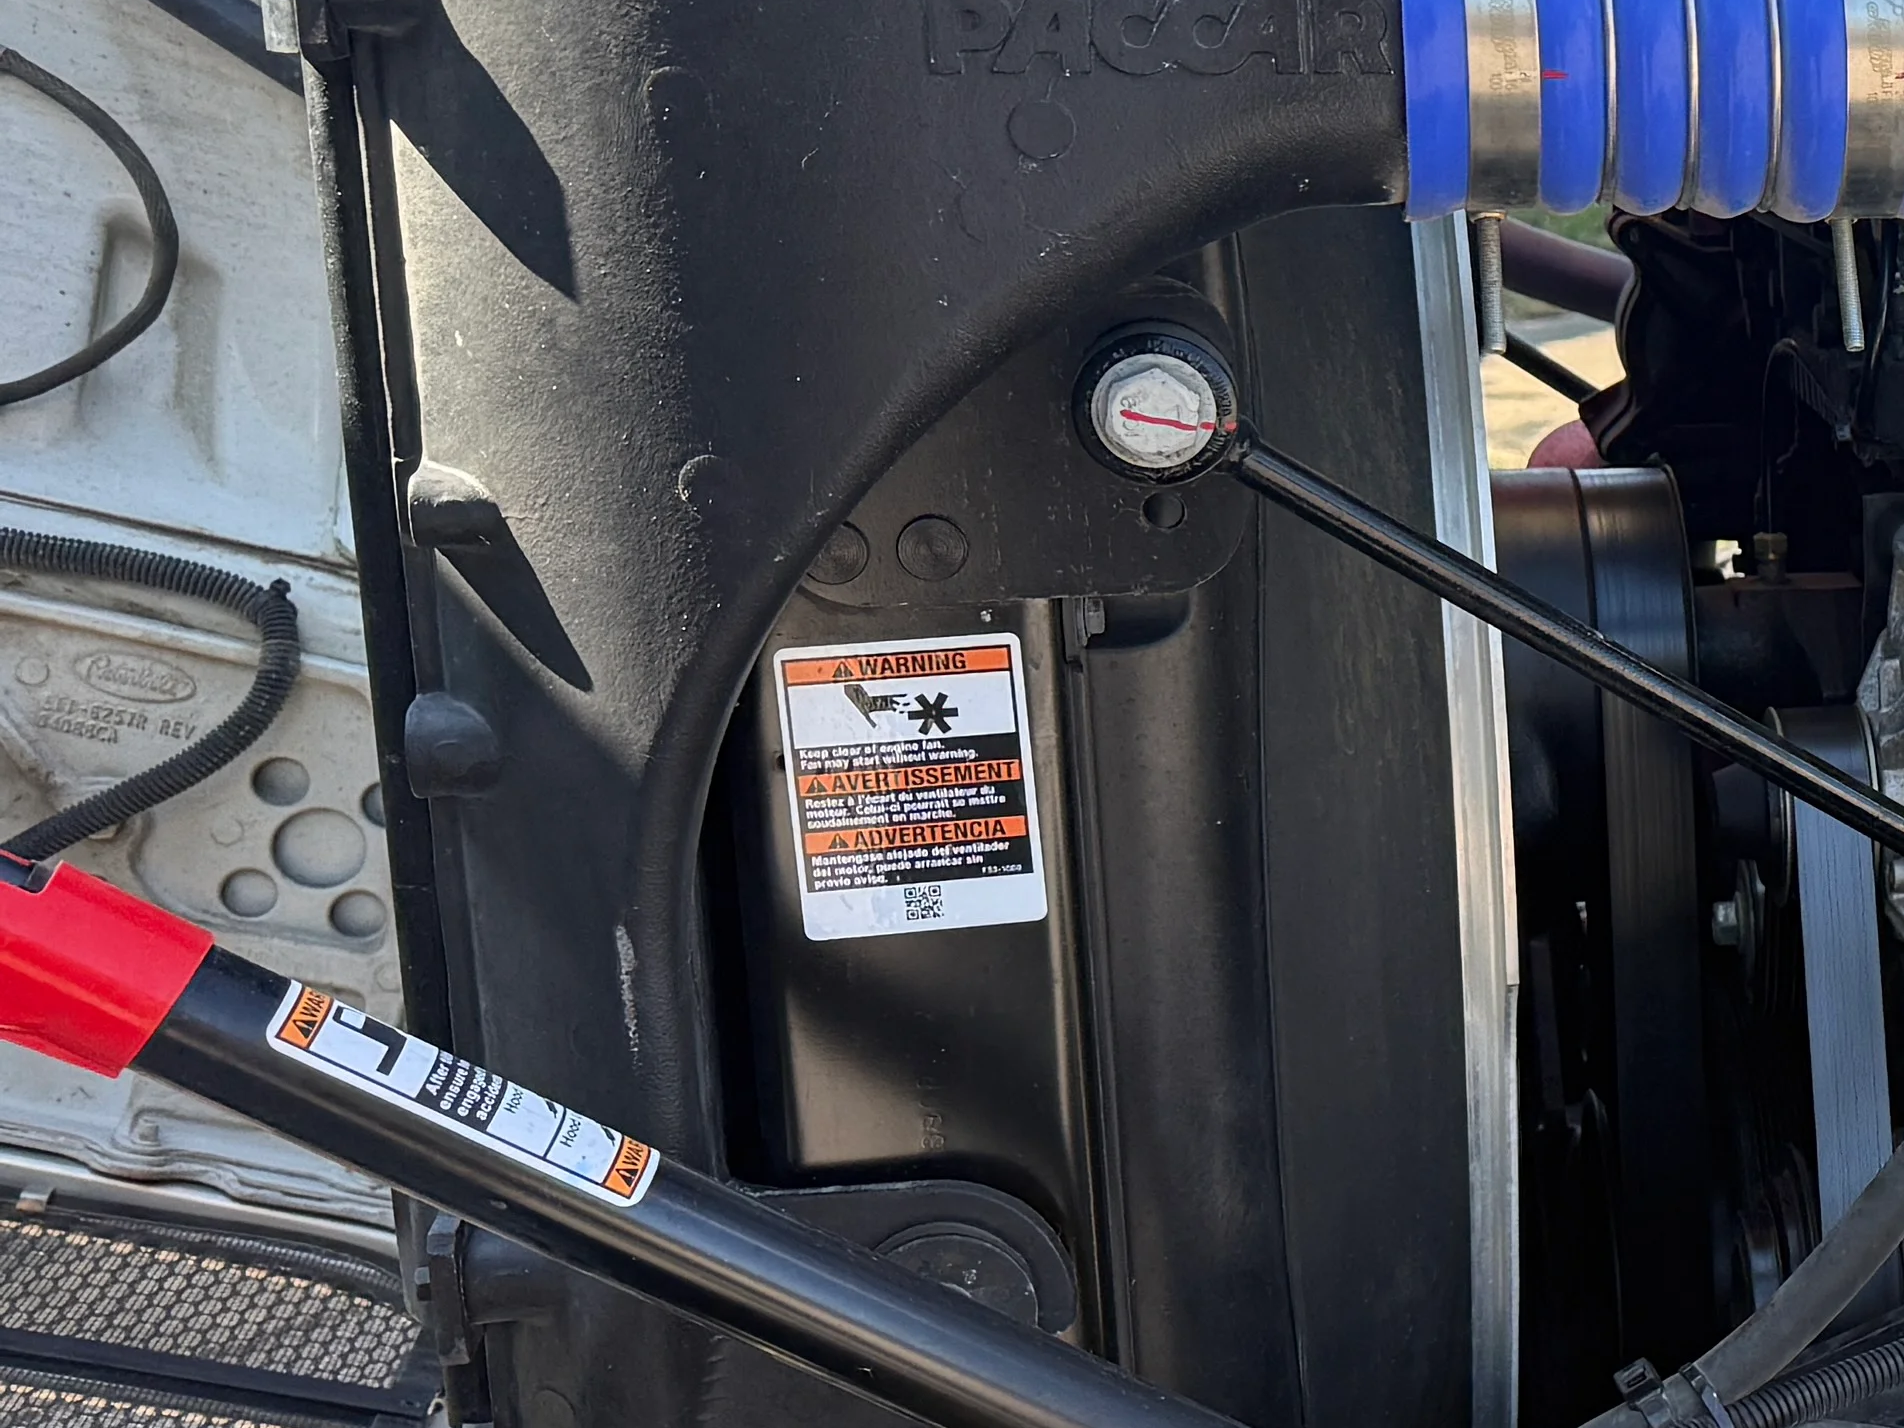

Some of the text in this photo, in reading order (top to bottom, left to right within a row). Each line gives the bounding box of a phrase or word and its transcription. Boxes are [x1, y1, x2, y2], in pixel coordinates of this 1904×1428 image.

[857, 651, 967, 676] WARNING
[157, 716, 197, 741] REV
[799, 747, 829, 761] Keep
[831, 745, 861, 758] clear
[863, 743, 879, 756] of
[921, 738, 945, 751] fan.
[800, 759, 822, 770] Fan
[824, 757, 851, 770] may
[852, 754, 880, 767] start
[928, 746, 979, 763] warning.
[830, 760, 1016, 793] AVERTISSEMENT
[852, 818, 1006, 848] ADVERTENCIA
[422, 1059, 451, 1097] After
[437, 1064, 469, 1113] ensure
[558, 1116, 583, 1149] Hood
